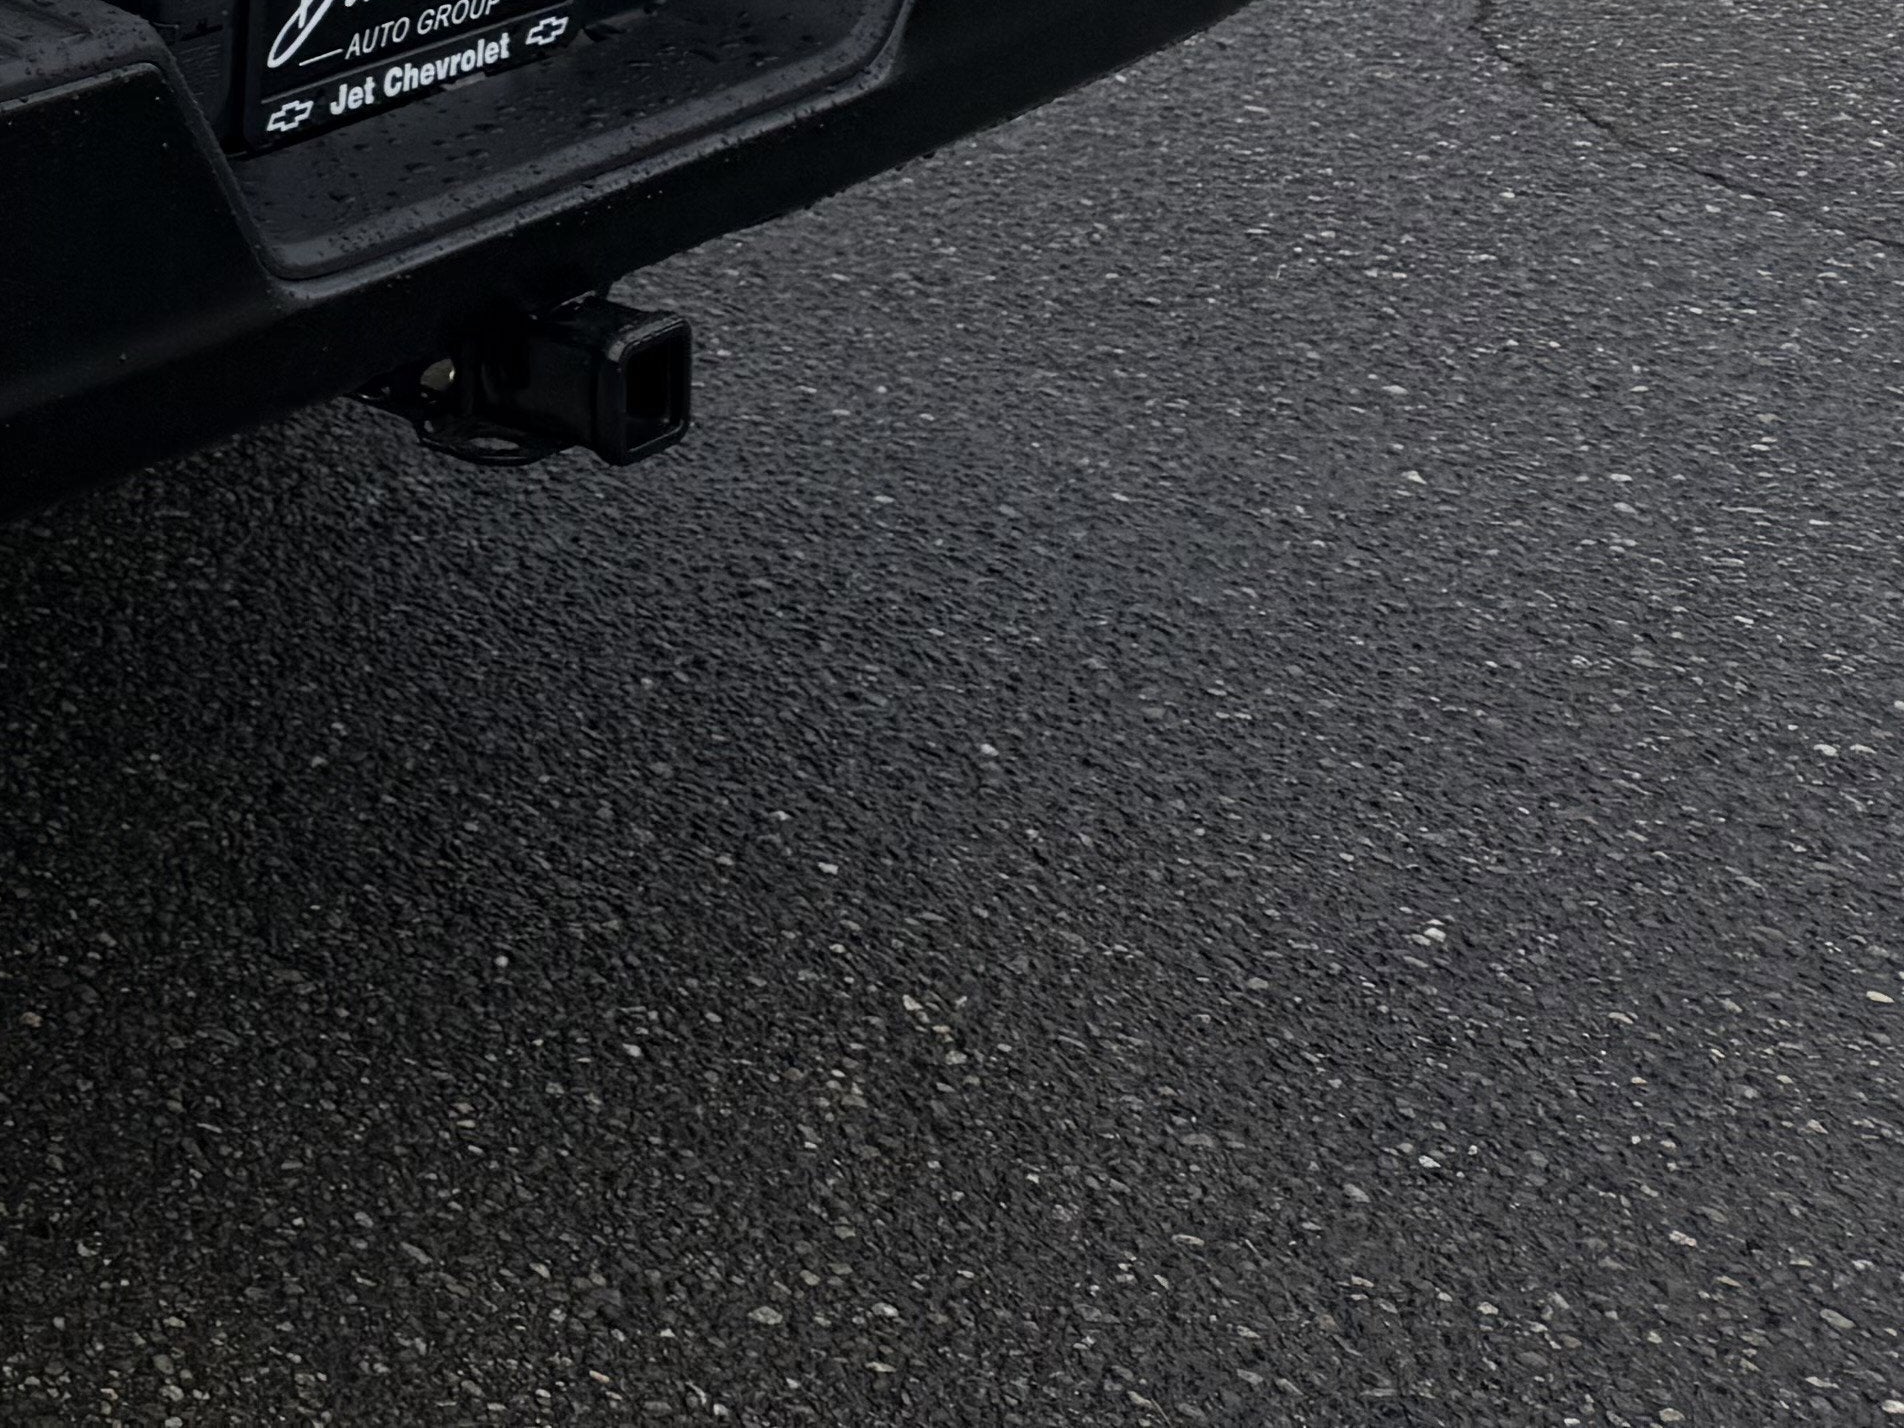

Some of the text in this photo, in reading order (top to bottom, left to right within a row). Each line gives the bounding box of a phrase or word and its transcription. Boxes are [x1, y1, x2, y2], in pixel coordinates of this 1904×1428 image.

[345, 16, 410, 60] AUTO
[330, 32, 510, 116] Jet Chevrolet
